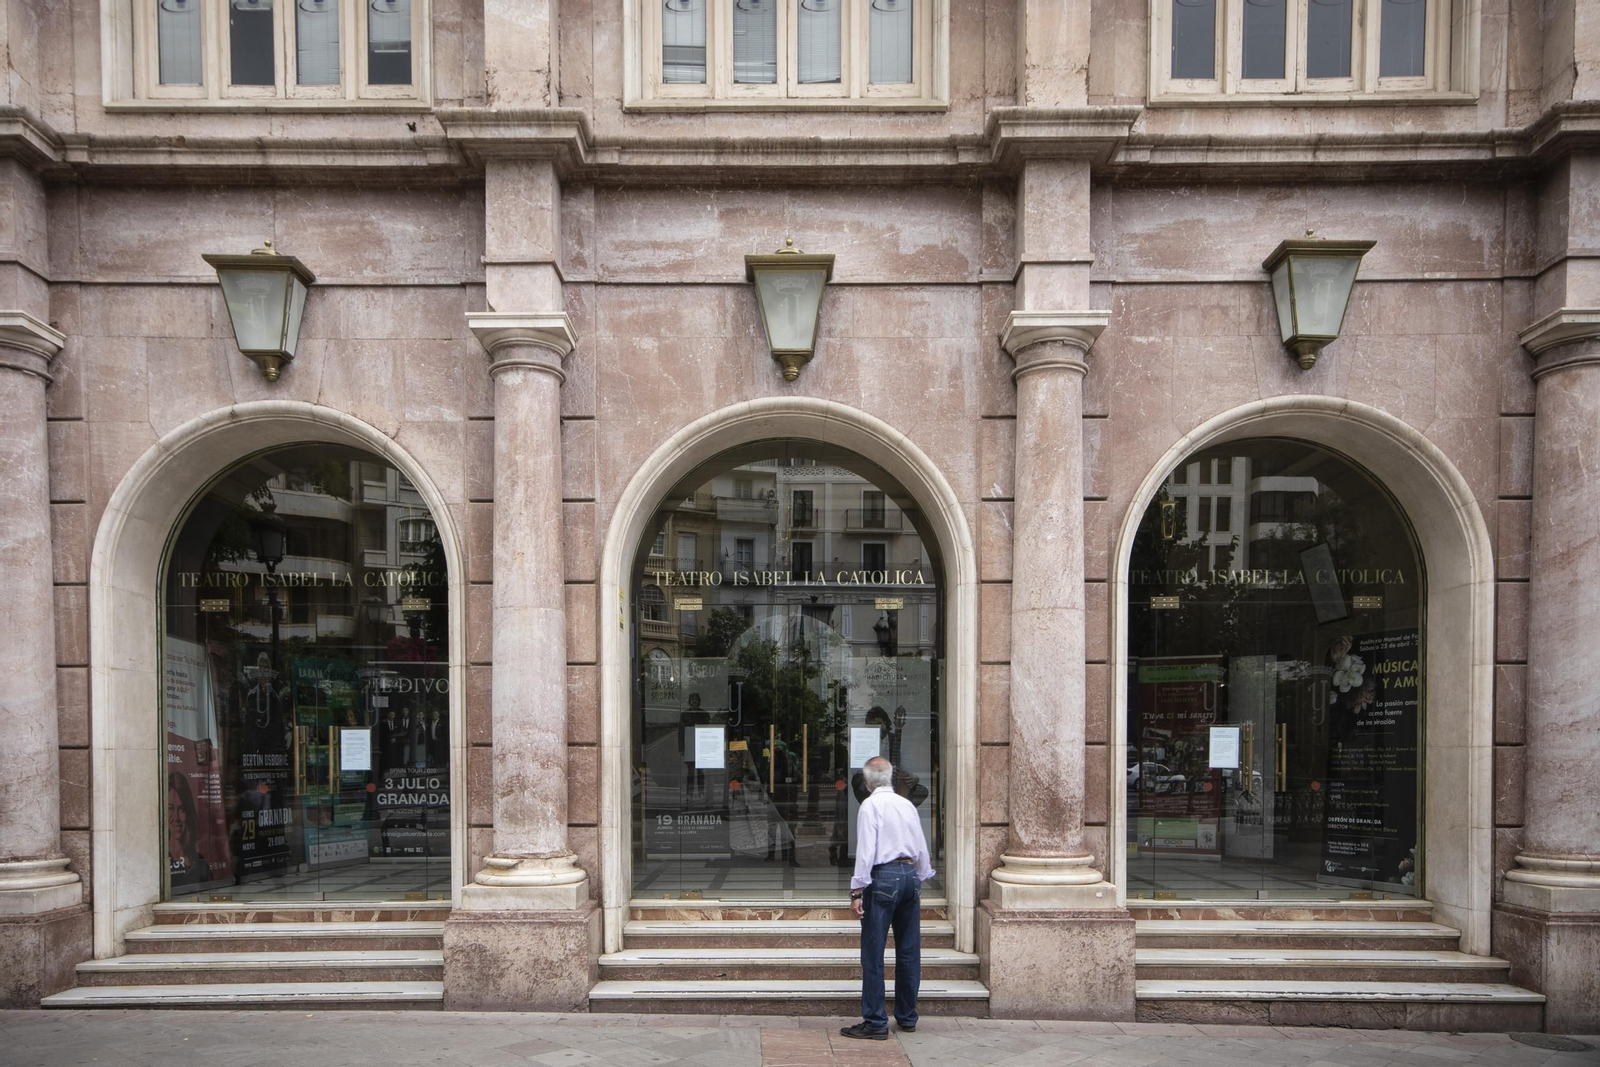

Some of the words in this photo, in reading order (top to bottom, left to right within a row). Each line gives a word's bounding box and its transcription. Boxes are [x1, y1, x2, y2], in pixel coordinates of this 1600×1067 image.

[178, 572, 249, 587] TEATRO
[261, 572, 324, 587] ISABEL
[331, 572, 354, 587] LA
[363, 571, 448, 587] CATOLICA
[652, 571, 722, 586] TEATRO
[733, 571, 796, 586] ISABEL
[804, 571, 827, 586] LA
[837, 570, 925, 586] CATOLICA
[1129, 569, 1198, 584] TEATRO
[1211, 569, 1272, 584] ISABEL
[1283, 569, 1306, 584] LA
[1316, 569, 1405, 584] CATOLICA
[1372, 658, 1418, 674] MÚSICA
[398, 678, 449, 694] DIVO
[1382, 677, 1389, 689] Y
[1394, 676, 1418, 688] AM
[1384, 700, 1403, 708] pasión
[1142, 712, 1164, 723] Tuya
[242, 750, 264, 766] BERTÍN
[385, 778, 393, 789] 3
[397, 778, 440, 789] JULIO
[377, 793, 450, 805] GRANADA
[259, 808, 293, 827] GRANADA
[656, 814, 673, 825] 19
[678, 815, 722, 825] GRANADA
[242, 819, 255, 840] 29
